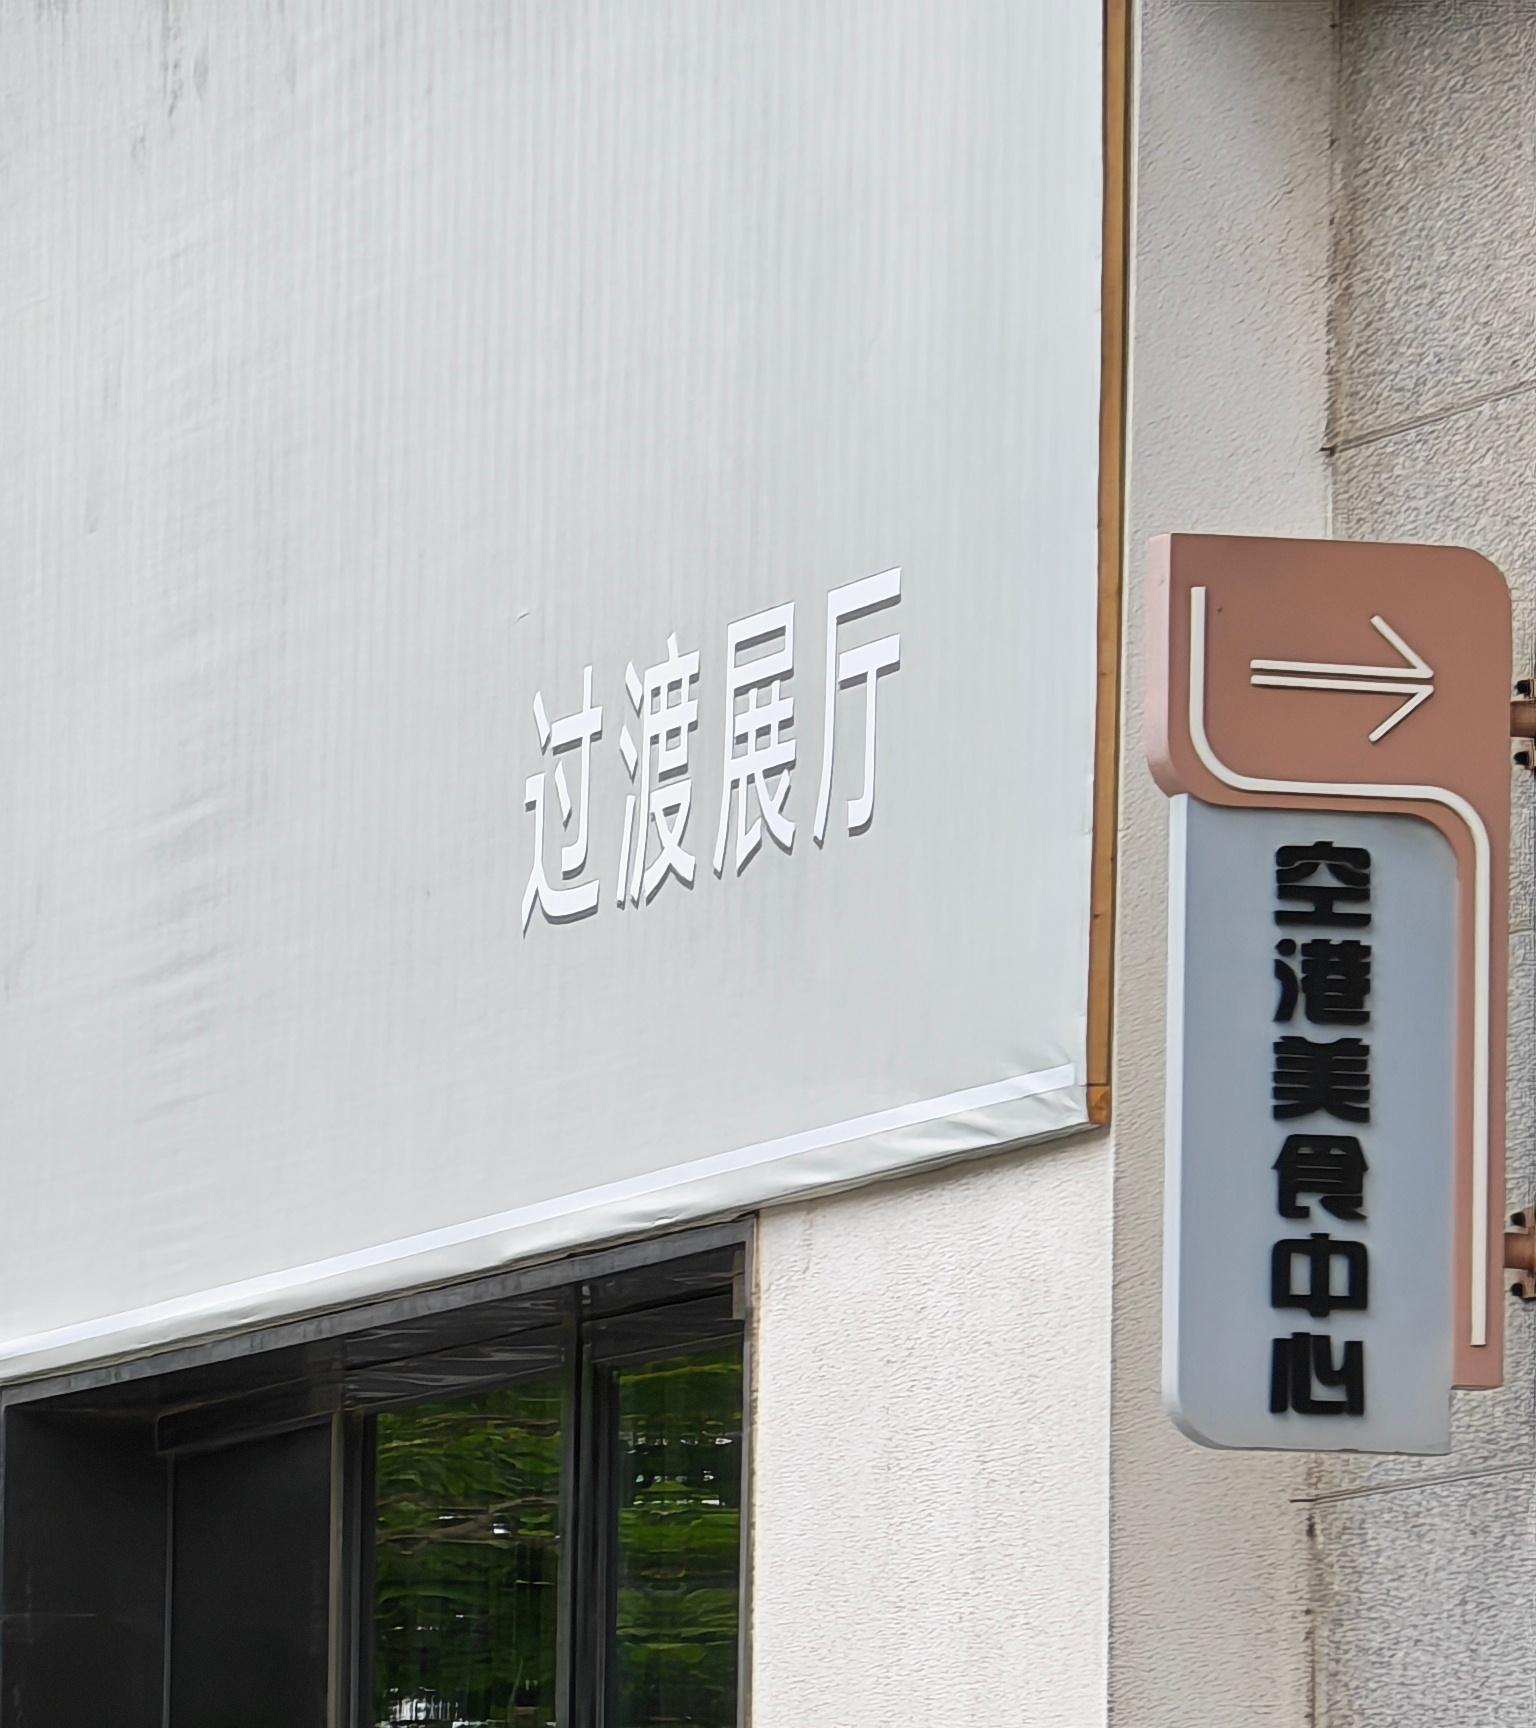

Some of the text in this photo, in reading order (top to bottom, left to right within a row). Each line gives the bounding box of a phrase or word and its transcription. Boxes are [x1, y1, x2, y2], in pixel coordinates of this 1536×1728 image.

[521, 566, 901, 938] 过渡展厅
[1269, 841, 1372, 1416] 空港美食中心
